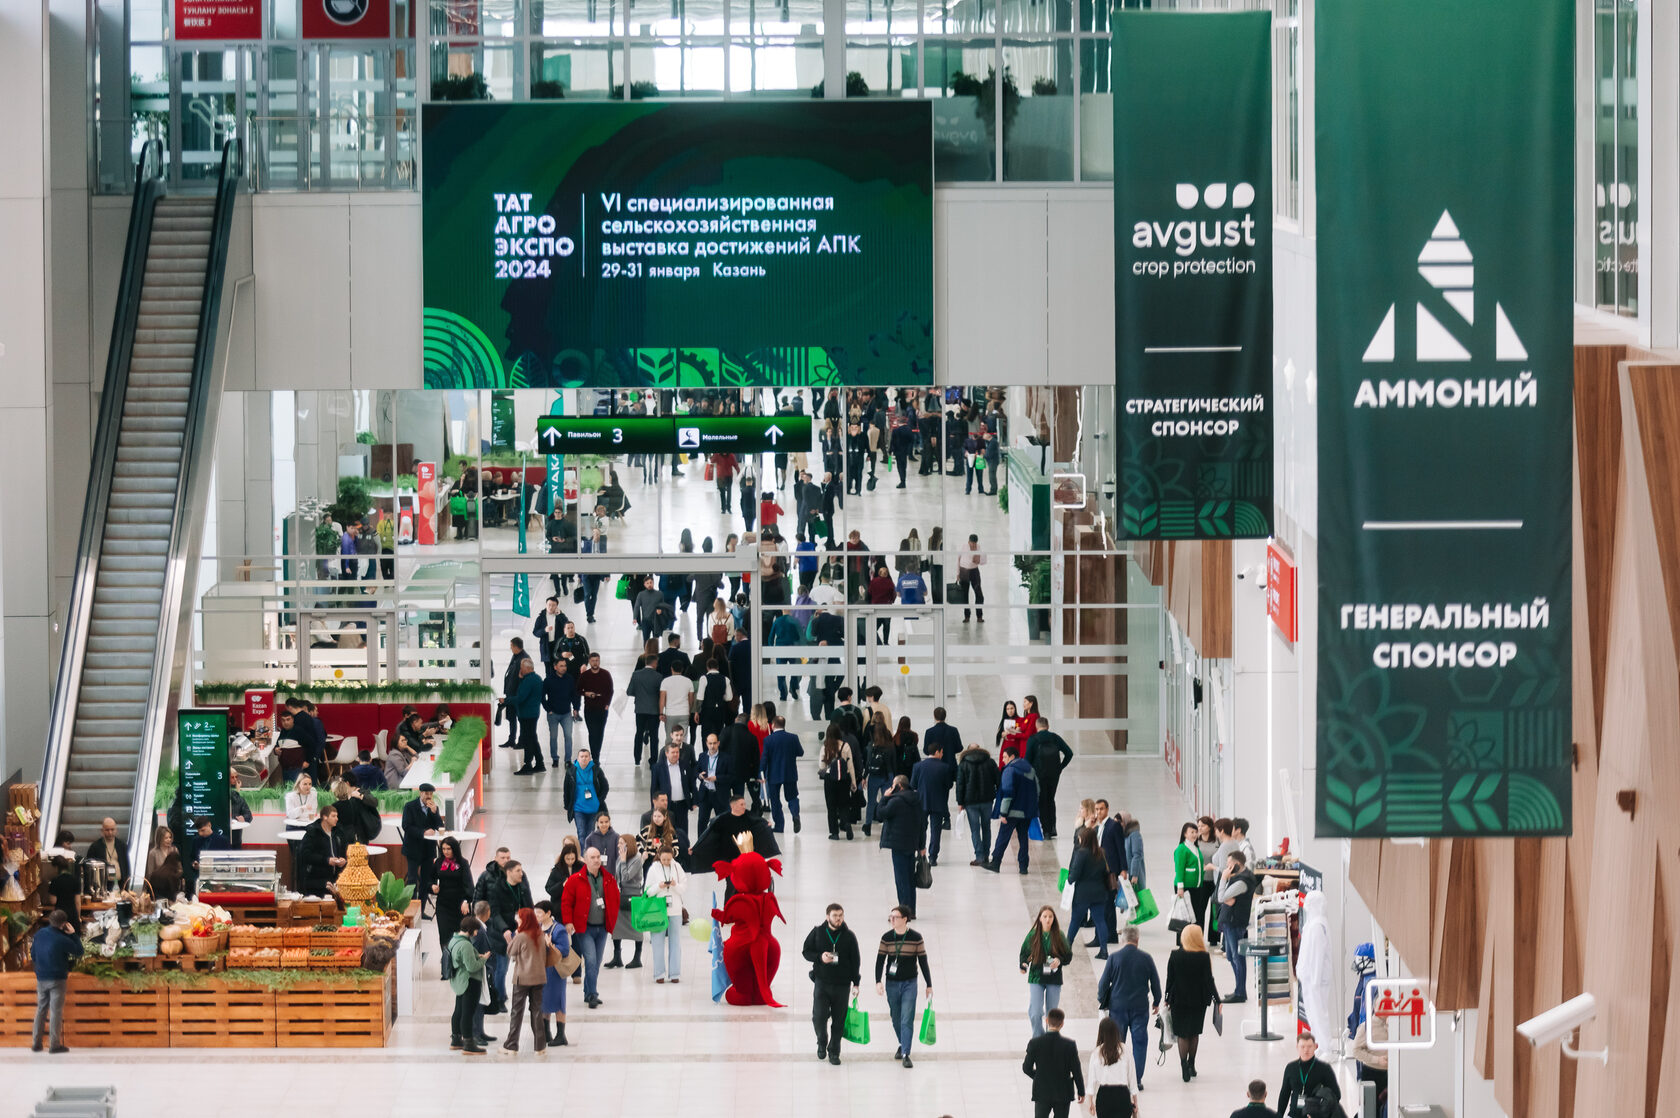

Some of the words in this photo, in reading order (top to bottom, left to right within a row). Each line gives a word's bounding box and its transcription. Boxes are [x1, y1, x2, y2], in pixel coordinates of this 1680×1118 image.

[494, 193, 533, 212] ТАТ
[601, 193, 621, 212] VI
[626, 195, 834, 216] специализированная
[494, 215, 556, 234] АГРО
[601, 214, 817, 234] сельскохозяйственная
[1132, 213, 1256, 257] avgust
[494, 237, 575, 257] ЭКСПО
[602, 240, 690, 256] выставка
[694, 236, 811, 259] достижений
[816, 234, 862, 254] АПК
[494, 259, 552, 279] 2024
[601, 262, 642, 278] 29-31
[649, 266, 701, 282] января
[712, 262, 767, 277] Казань
[1132, 260, 1170, 279] crop
[1173, 256, 1256, 279] protection
[1353, 371, 1538, 408] АММОНИЙ
[1125, 393, 1264, 414] СТРАТЕГИЧЕСКИЙ
[567, 431, 602, 439] Павильон
[612, 428, 623, 444] 3
[1151, 420, 1240, 437] СПОНСОР
[1340, 597, 1550, 630] ГЕНЕРАЛЬНЫЙ
[1372, 642, 1518, 668] СПОНСОР
[217, 771, 223, 780] 3
